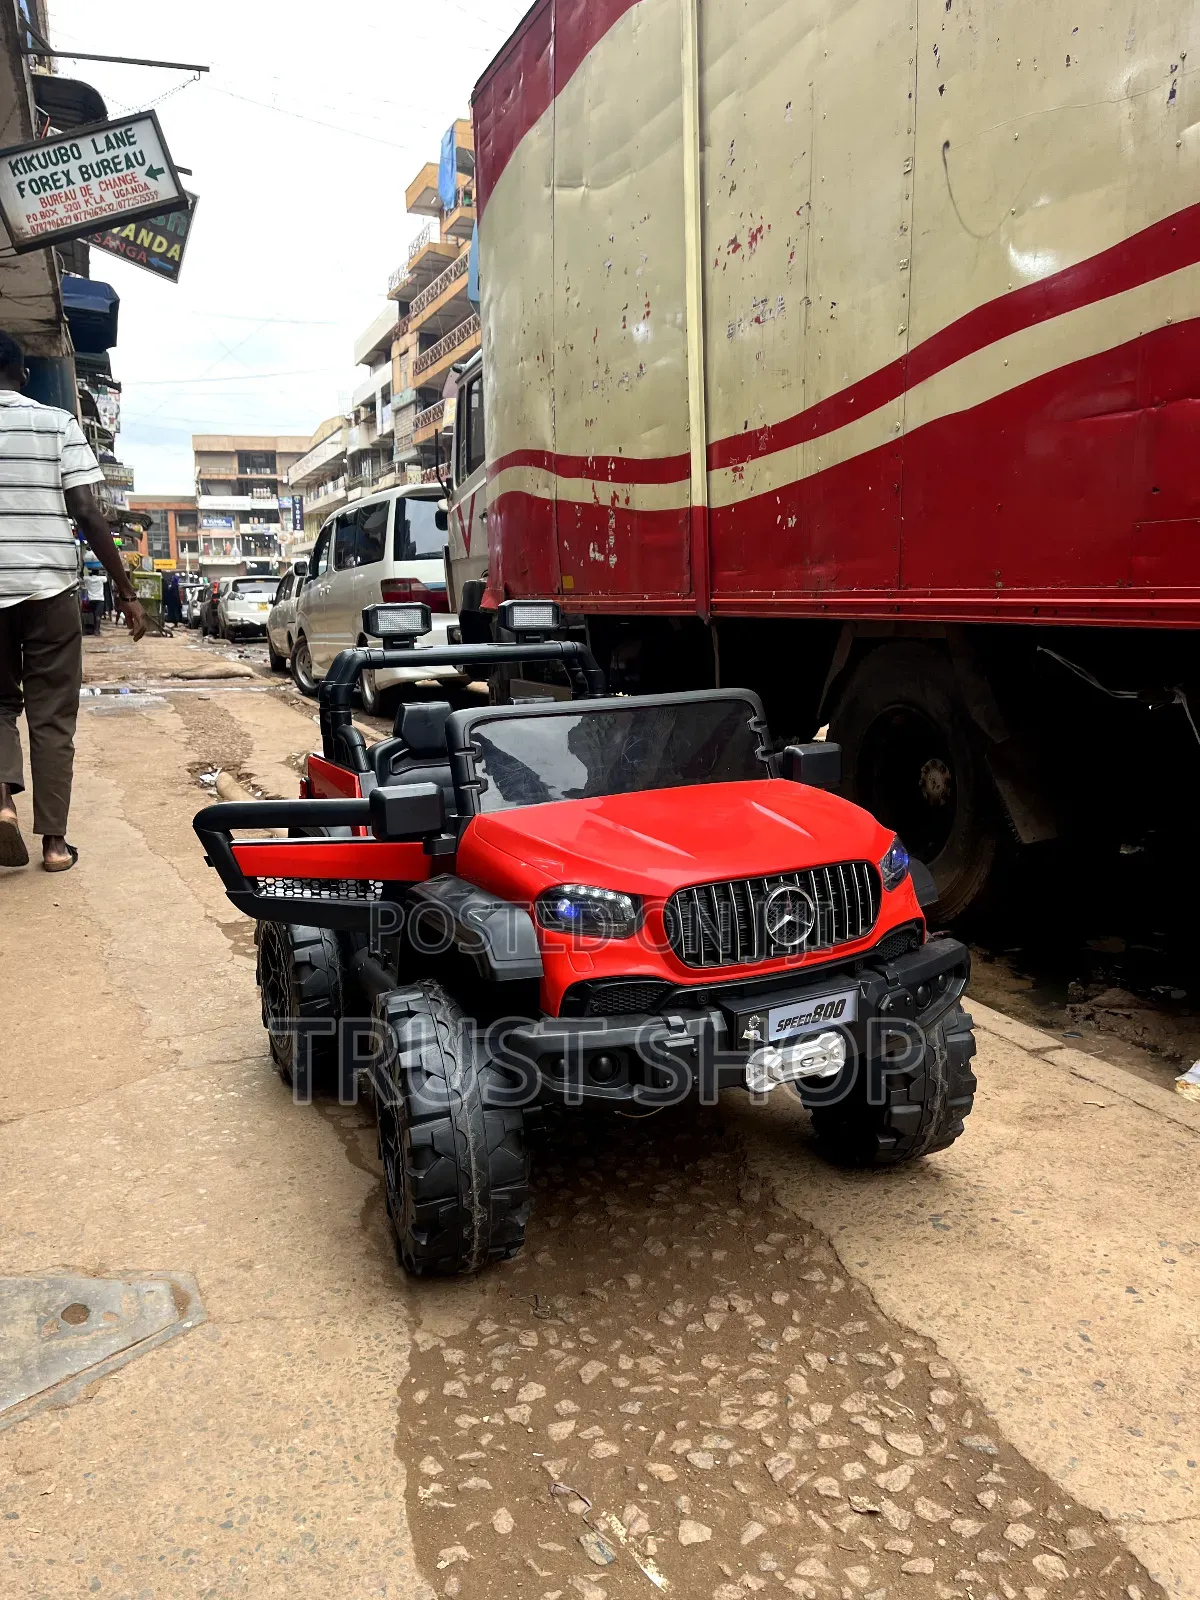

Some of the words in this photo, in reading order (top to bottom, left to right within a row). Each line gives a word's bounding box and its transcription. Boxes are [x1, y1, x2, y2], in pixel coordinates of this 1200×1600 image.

[8, 143, 82, 177] KIKUUBO
[91, 127, 137, 155] LANE
[16, 169, 76, 199] FOREX
[78, 149, 146, 183] BUREAU
[39, 188, 77, 208] BUREAU
[79, 184, 94, 198] DE
[98, 172, 139, 192] CHANGE
[63, 201, 82, 213] 5201
[113, 182, 151, 199] UGANDA
[112, 223, 181, 262] ANDA
